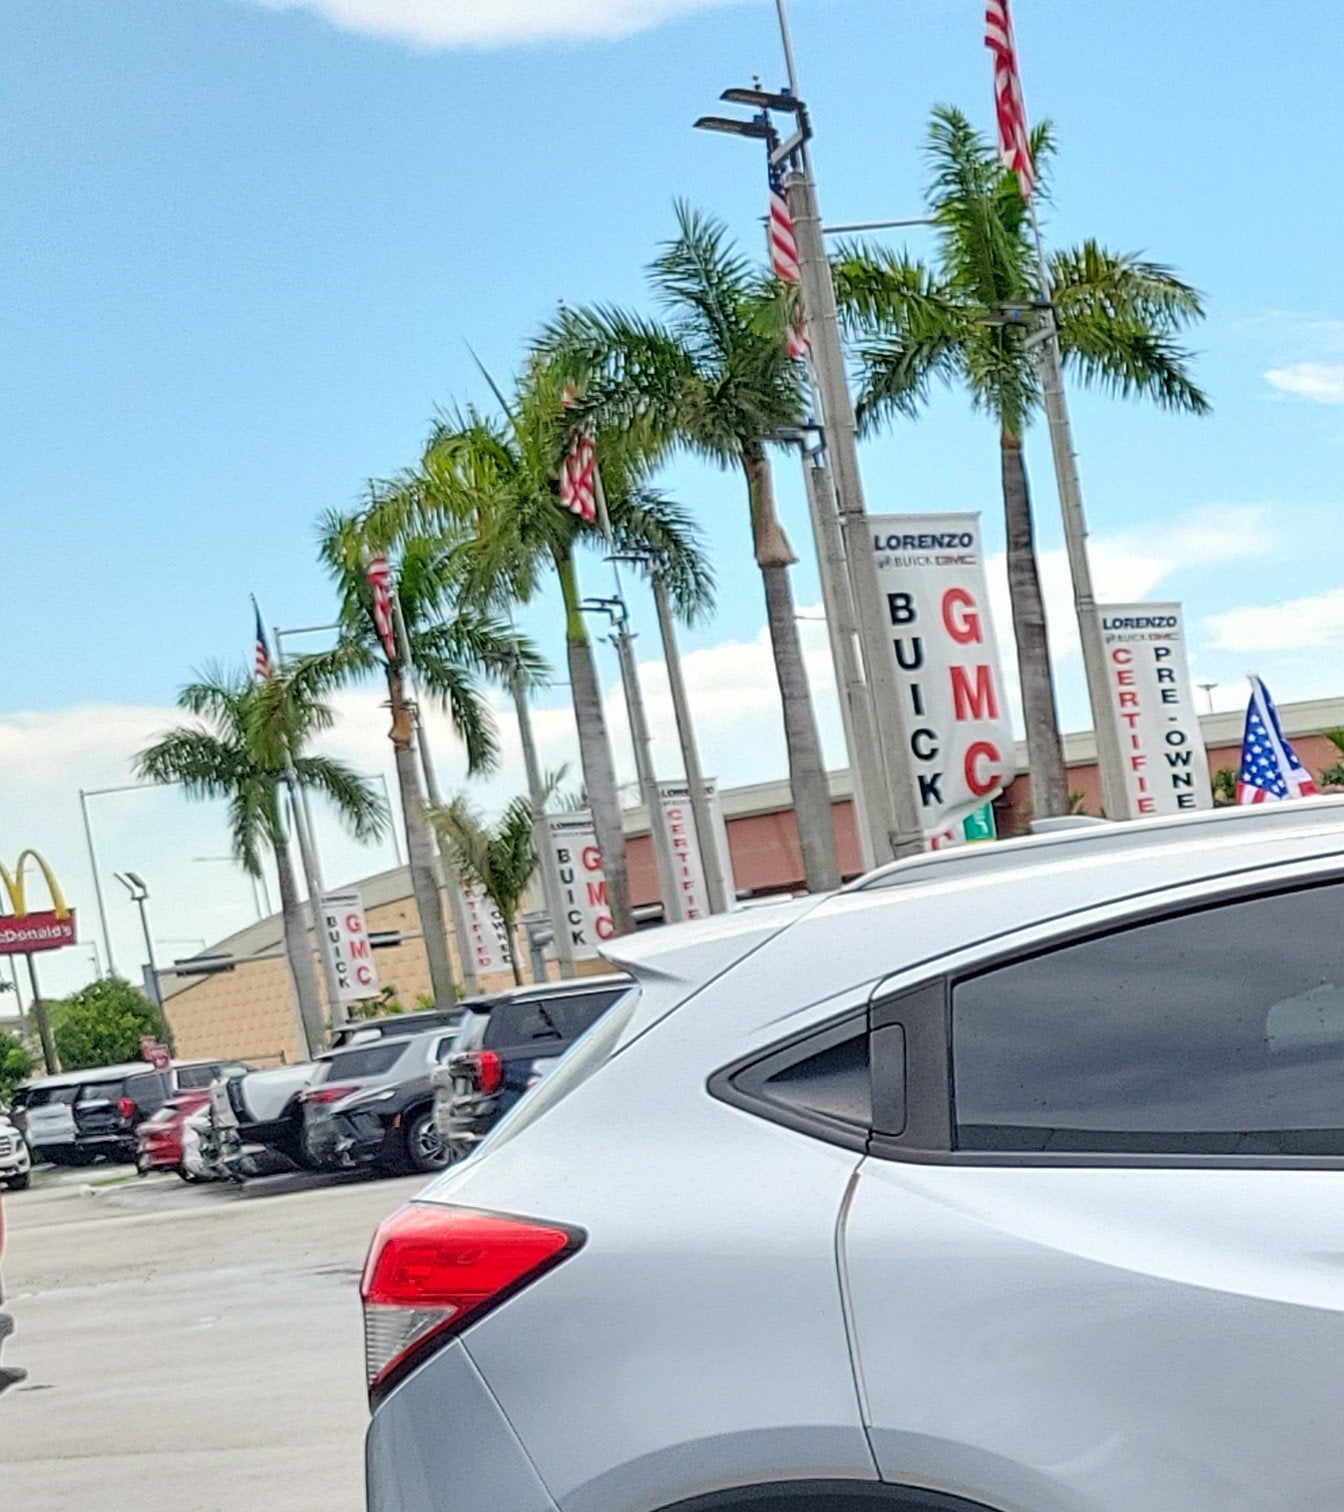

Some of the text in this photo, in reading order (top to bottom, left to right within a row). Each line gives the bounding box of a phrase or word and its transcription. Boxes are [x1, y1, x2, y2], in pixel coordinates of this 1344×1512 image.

[874, 533, 973, 551] LORENZO
[1103, 616, 1177, 630] LORENZO
[887, 591, 943, 807] BUICK
[941, 588, 1001, 797] GMC
[1112, 648, 1156, 813] CERTIFIE
[1154, 647, 1196, 809] PRE-OWNE
[557, 849, 586, 945] BUICK
[667, 810, 698, 920] CERTIFIE
[345, 914, 372, 985] GMC
